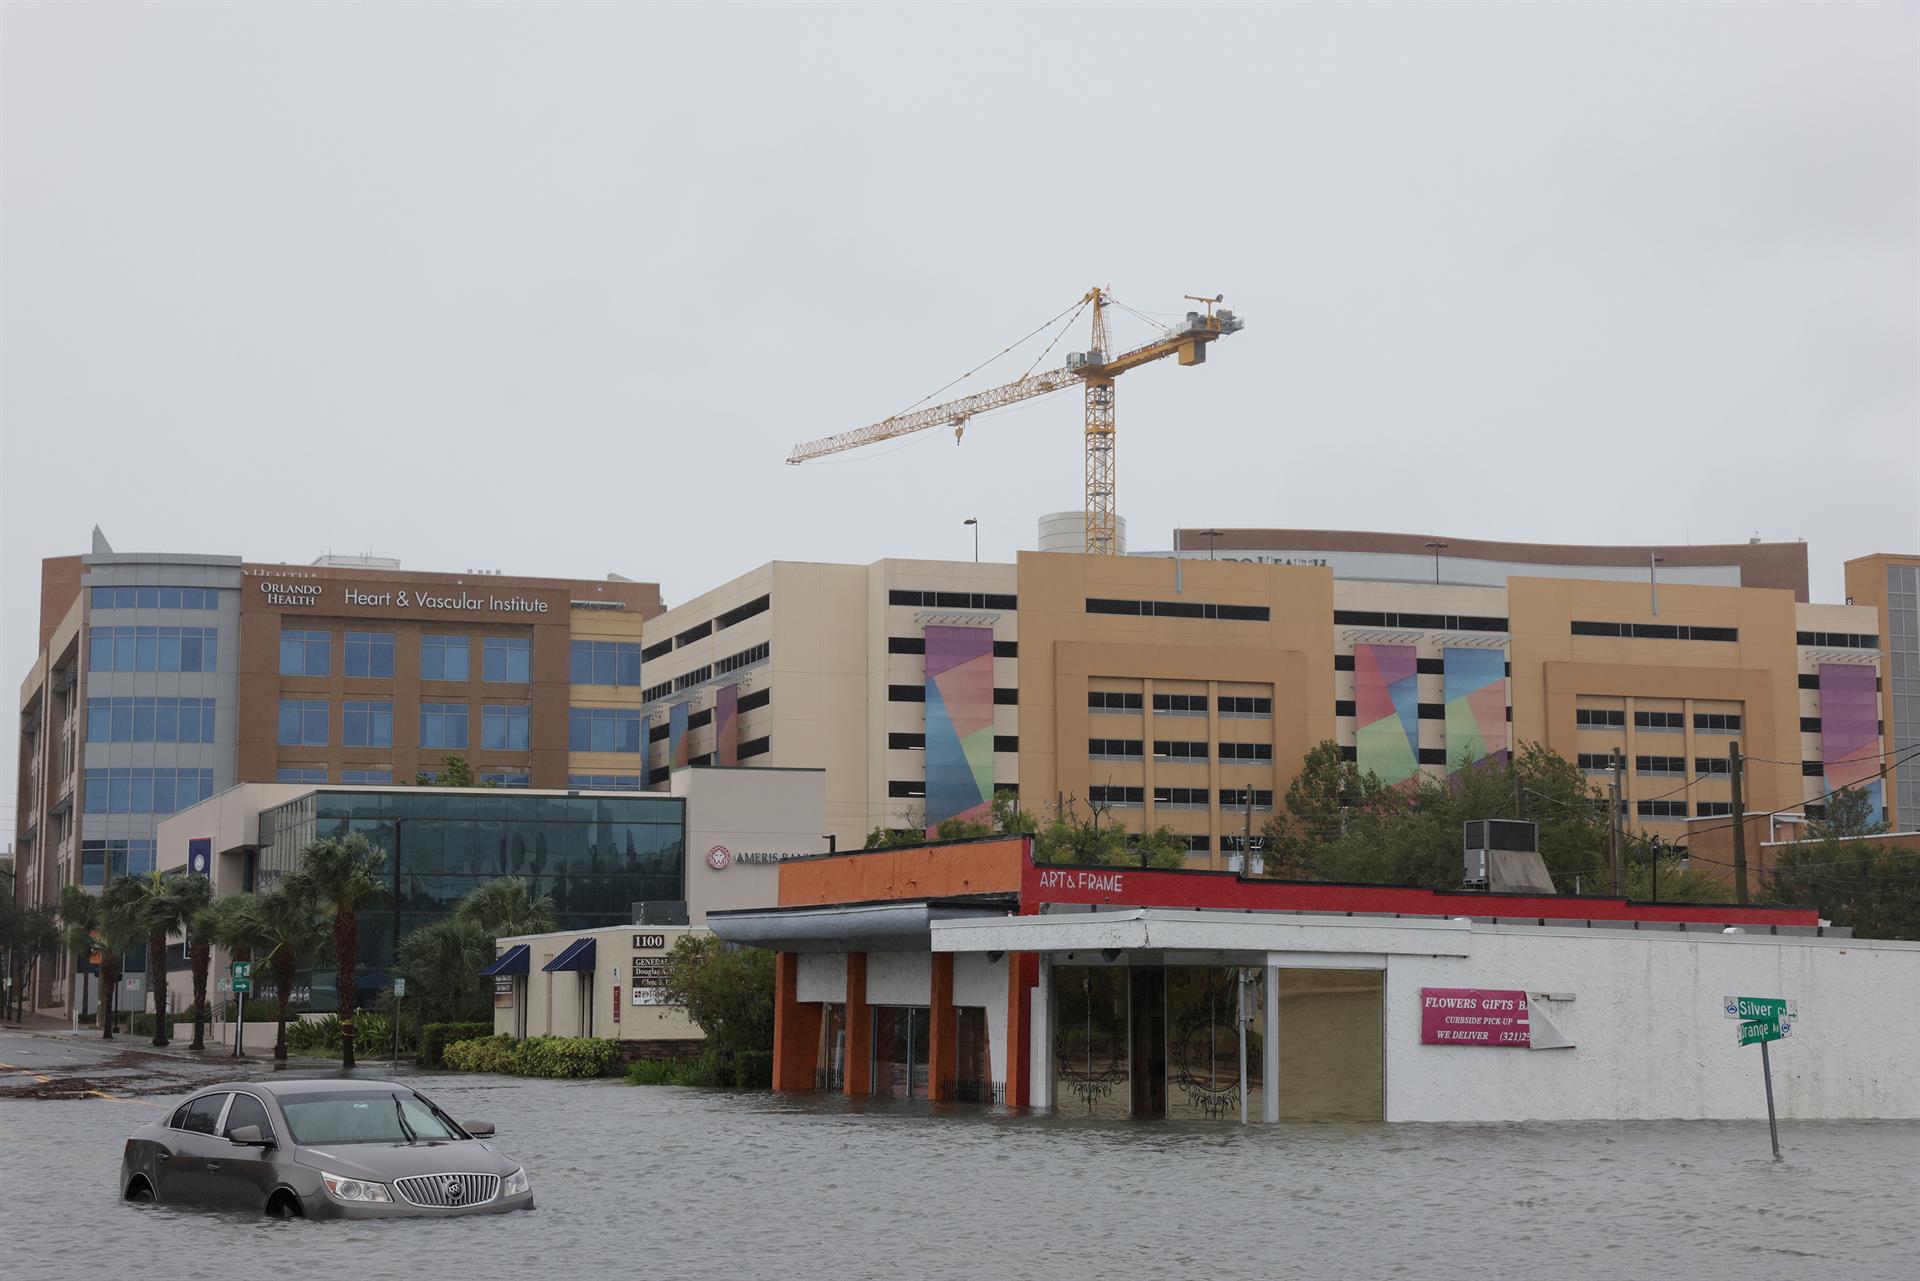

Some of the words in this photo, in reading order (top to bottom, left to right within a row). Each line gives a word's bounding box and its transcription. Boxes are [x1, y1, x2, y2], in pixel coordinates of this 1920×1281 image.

[261, 582, 322, 595] ORLANDO
[268, 593, 315, 605] HEALTH
[345, 588, 391, 607] Heart
[396, 590, 409, 607] &
[415, 591, 484, 610] Vascular
[490, 594, 549, 613] Institute
[736, 852, 780, 864] AMERIS
[1079, 872, 1123, 892] FRAME
[635, 936, 663, 947] 1100
[1425, 997, 1477, 1009] FLOWERS
[1482, 999, 1514, 1010] GIFTS
[1740, 1001, 1772, 1017] Silver
[1778, 1007, 1786, 1017] Ct
[1445, 1016, 1483, 1025] CURBSIDE
[1483, 1017, 1513, 1025] PICK-UP
[1437, 1030, 1451, 1040] WE
[1452, 1031, 1489, 1040] DELIVER
